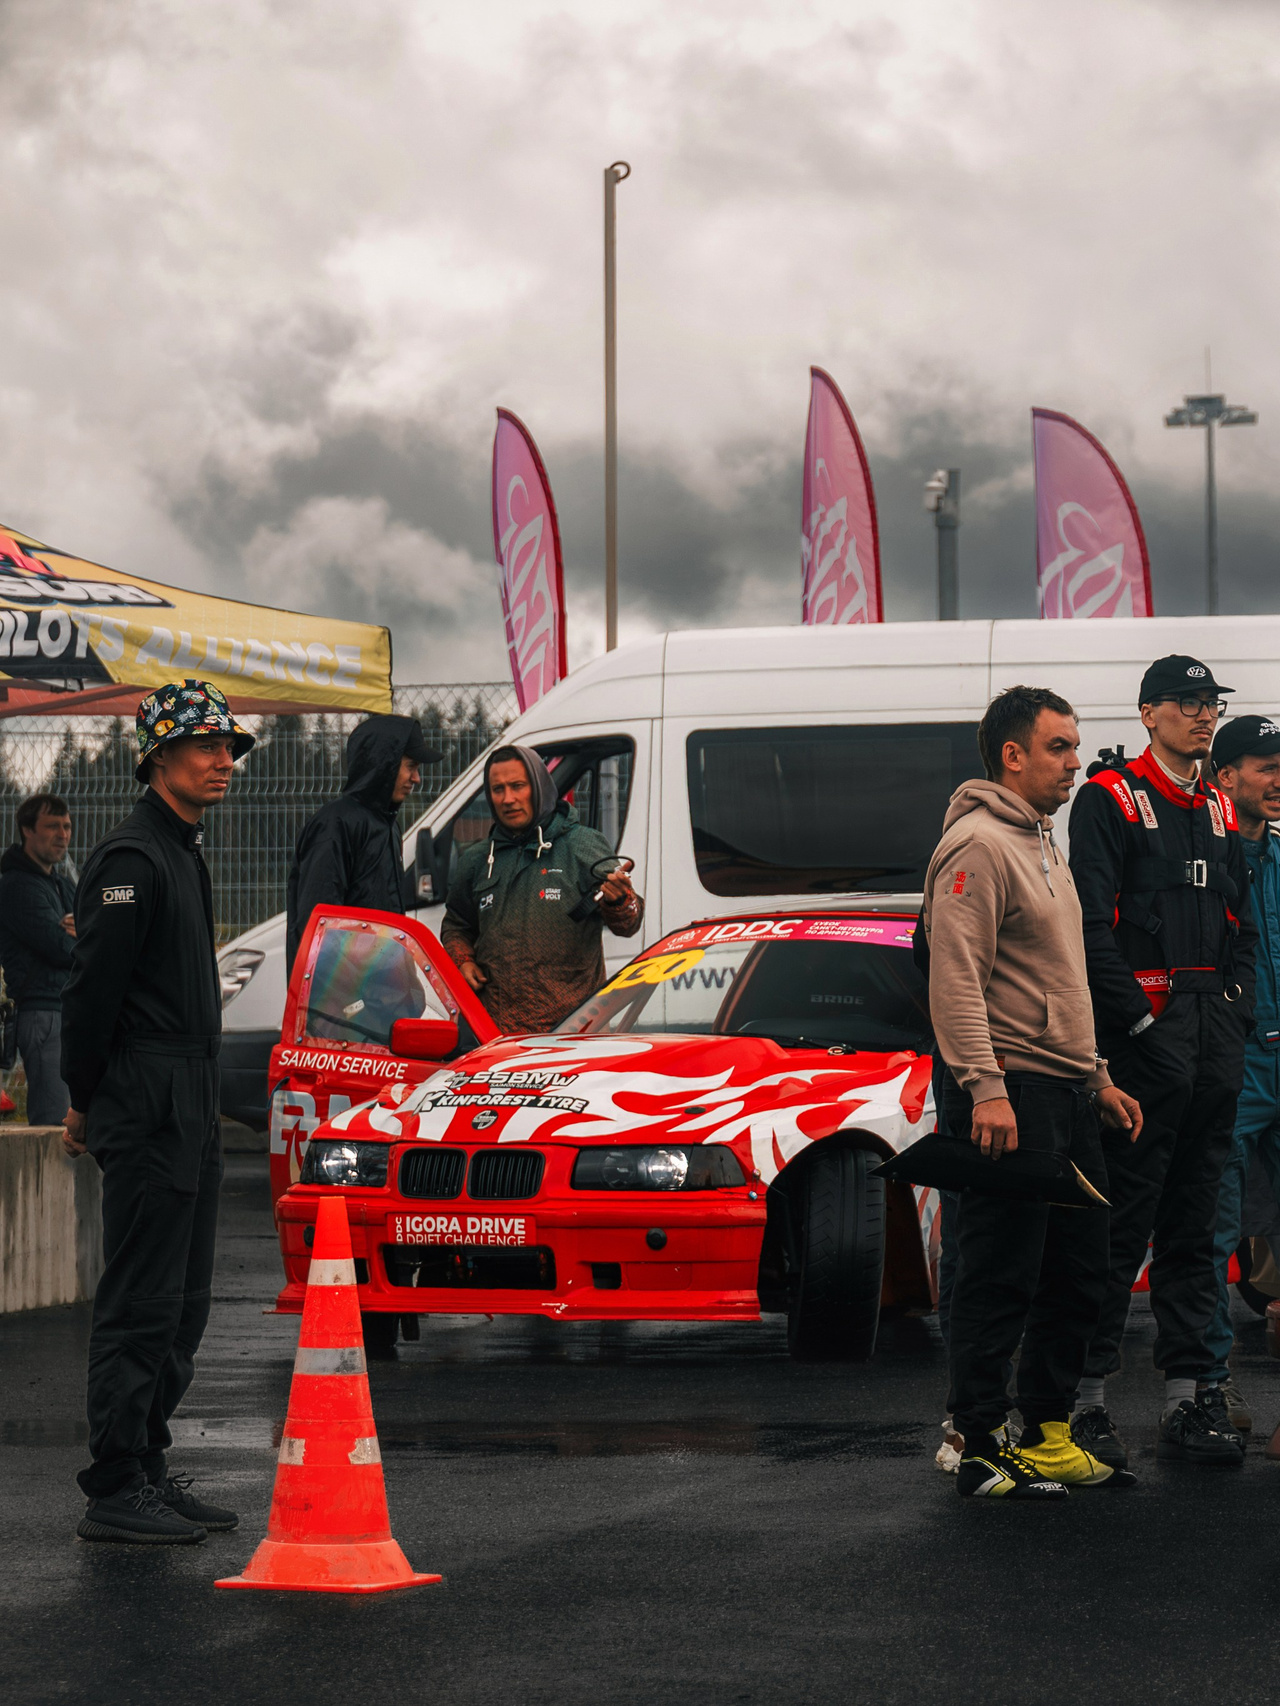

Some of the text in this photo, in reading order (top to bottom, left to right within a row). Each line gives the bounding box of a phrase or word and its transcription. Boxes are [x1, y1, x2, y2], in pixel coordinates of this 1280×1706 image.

[0, 609, 362, 688] ILOTS ALLIANCE
[1112, 783, 1134, 816] sparco
[103, 889, 135, 902] OMP
[702, 919, 803, 941] IDDC
[279, 1050, 408, 1080] SAIMON SERVICE
[470, 1072, 578, 1087] SSBMW
[437, 1093, 534, 1107] KINFOREST
[537, 1095, 588, 1112] TYRE
[406, 1216, 526, 1235] IGORA DRIVE
[406, 1234, 526, 1247] DRIFT CHALLENGE
